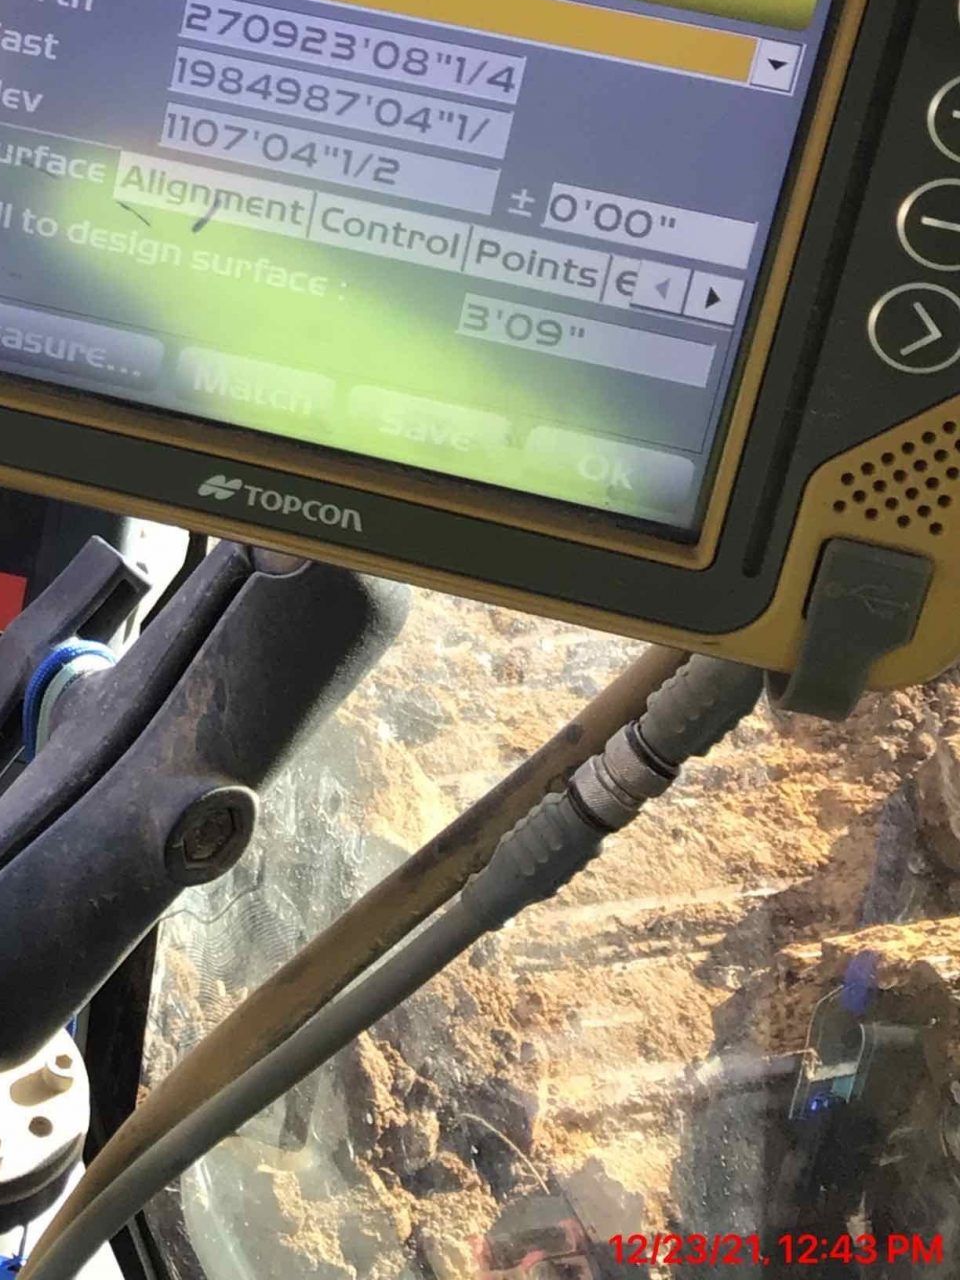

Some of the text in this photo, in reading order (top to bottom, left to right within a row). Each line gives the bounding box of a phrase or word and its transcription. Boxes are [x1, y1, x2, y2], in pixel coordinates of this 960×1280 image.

[120, 164, 306, 228] Alignment
[21, 208, 59, 238] to
[67, 221, 182, 268] design
[191, 251, 329, 298] surface
[320, 206, 459, 260] Control
[474, 239, 599, 289] Points
